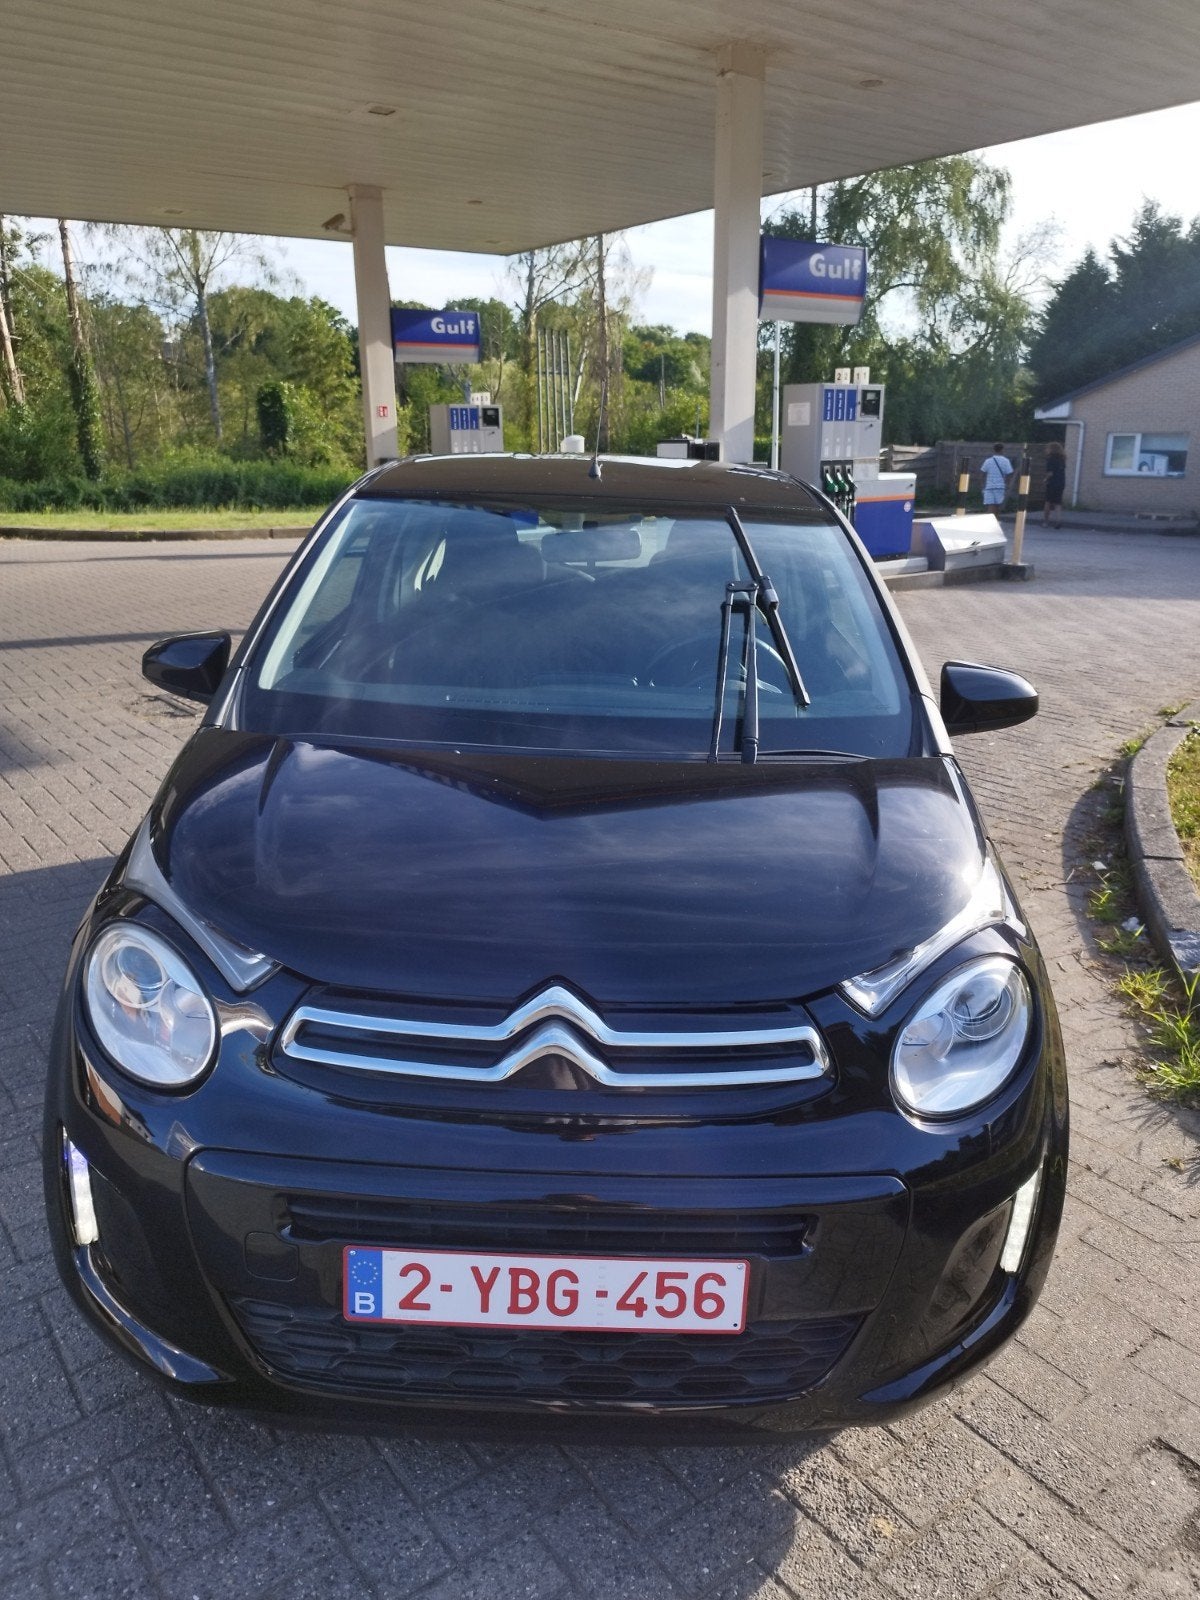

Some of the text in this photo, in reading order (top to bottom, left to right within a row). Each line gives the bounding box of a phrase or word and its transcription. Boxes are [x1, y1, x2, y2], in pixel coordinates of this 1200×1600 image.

[809, 253, 862, 280] Gulf
[431, 317, 475, 334] Gulf
[354, 1292, 375, 1314] B
